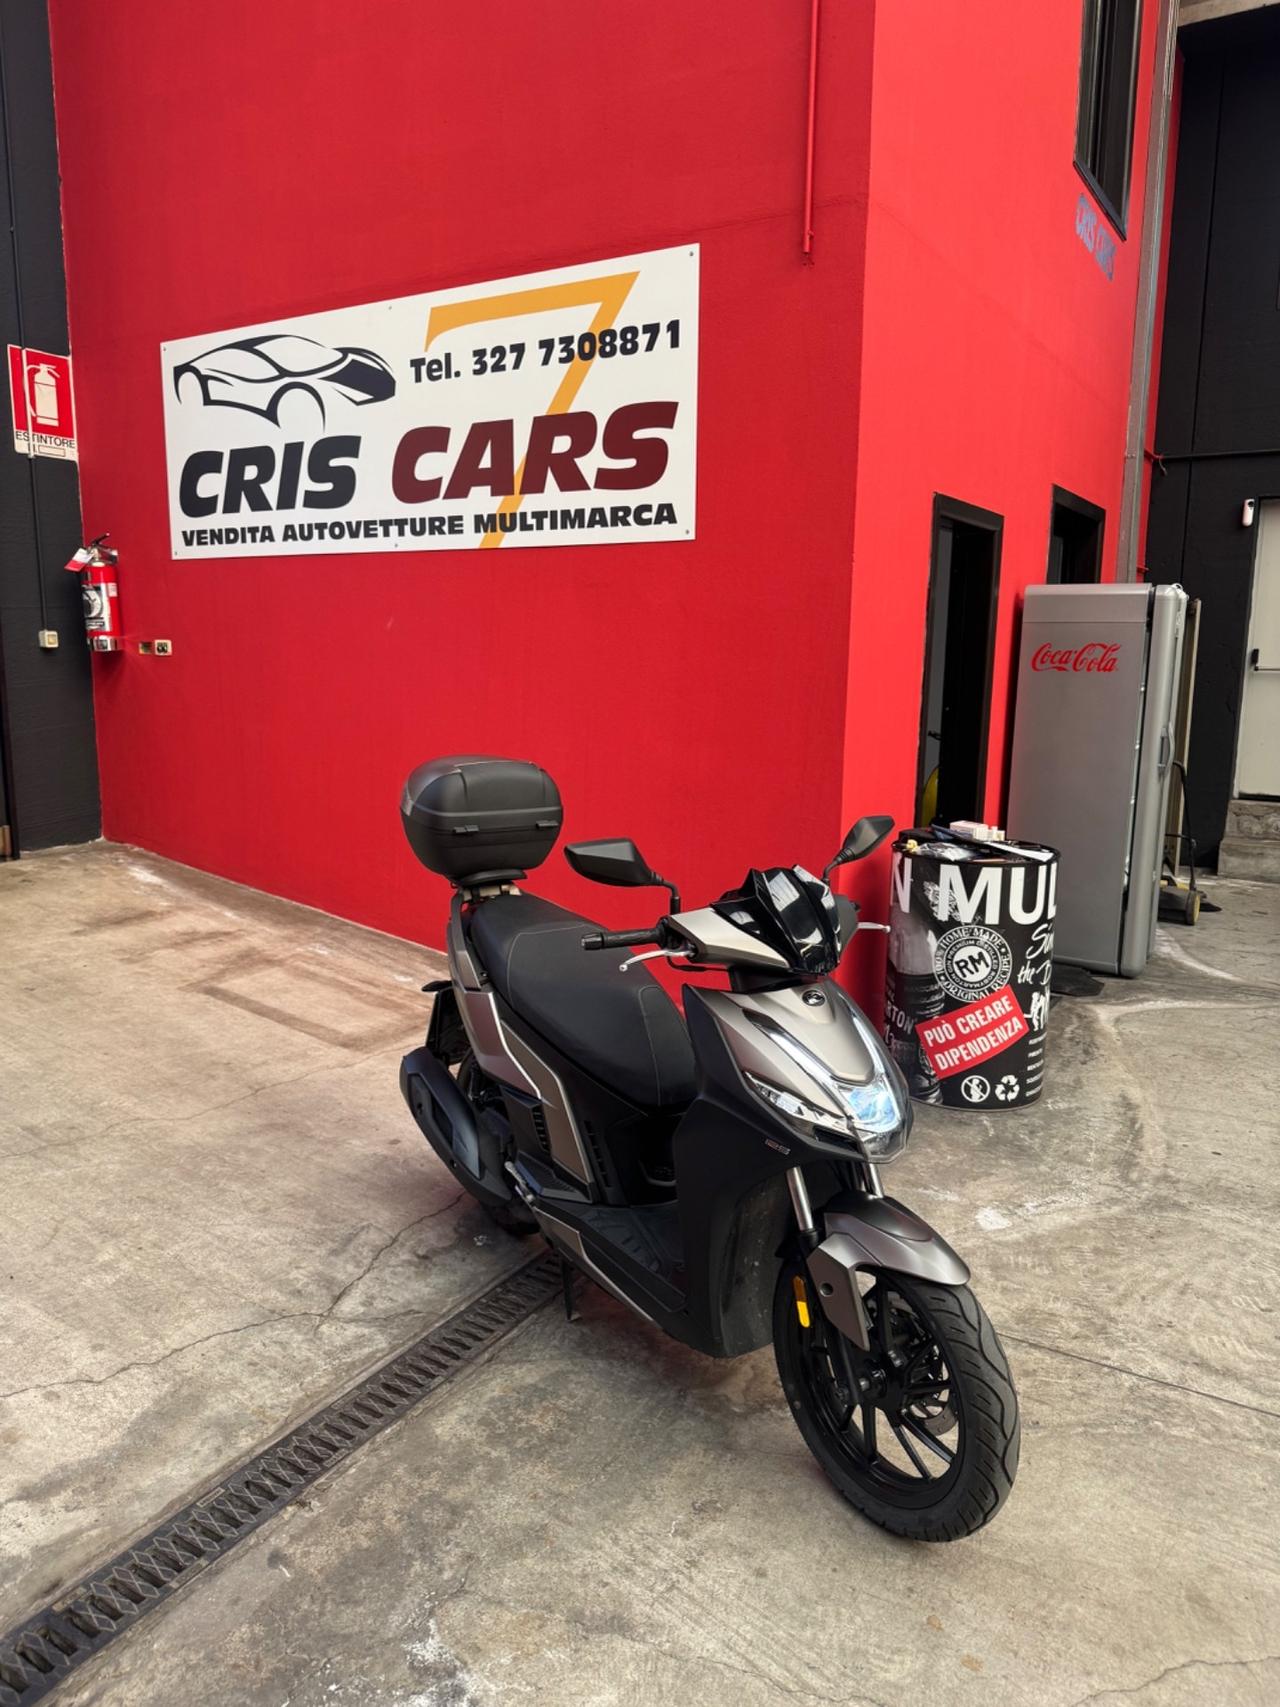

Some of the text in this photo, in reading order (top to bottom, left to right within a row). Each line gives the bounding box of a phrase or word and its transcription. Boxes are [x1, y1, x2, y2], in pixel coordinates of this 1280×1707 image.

[410, 319, 681, 383] Tel. 327 7308871
[15, 430, 76, 449] ESTINTORE
[179, 401, 679, 518] CRIS CARS
[181, 502, 677, 547] VENDITA AUTOVETTURE MULTIMARCA
[940, 927, 970, 949] HOME
[973, 927, 1004, 949] MADE
[955, 951, 990, 978] RM
[990, 953, 1011, 993] RECIPE
[923, 1020, 956, 1047] PUÒ
[955, 995, 1014, 1034] CREARE
[934, 1016, 1023, 1070] DIPENDENZA
